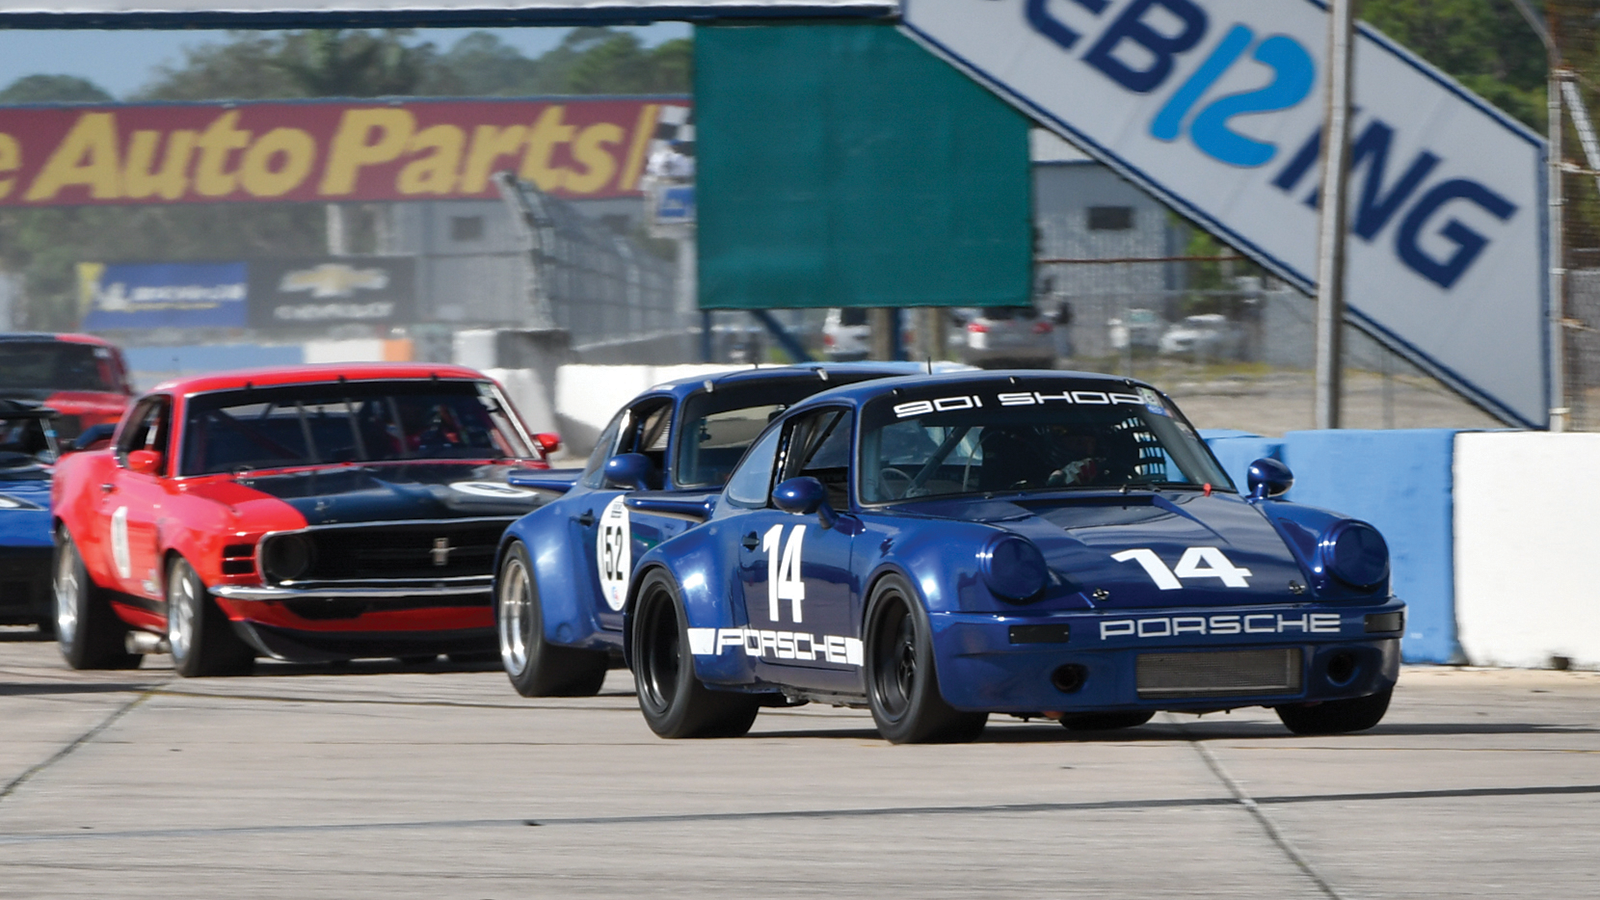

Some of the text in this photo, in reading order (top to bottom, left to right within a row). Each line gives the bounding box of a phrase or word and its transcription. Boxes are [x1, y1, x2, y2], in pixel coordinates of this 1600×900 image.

[25, 110, 316, 200] Auto
[318, 105, 624, 196] Parts
[1021, 0, 1519, 290] EB12ING
[893, 390, 1146, 418] 901 SHOP
[605, 526, 624, 581] 52
[763, 523, 808, 623] 14
[1110, 546, 1253, 590] 14
[716, 628, 847, 664] PORSCHE
[1100, 613, 1341, 641] PORSCHE
